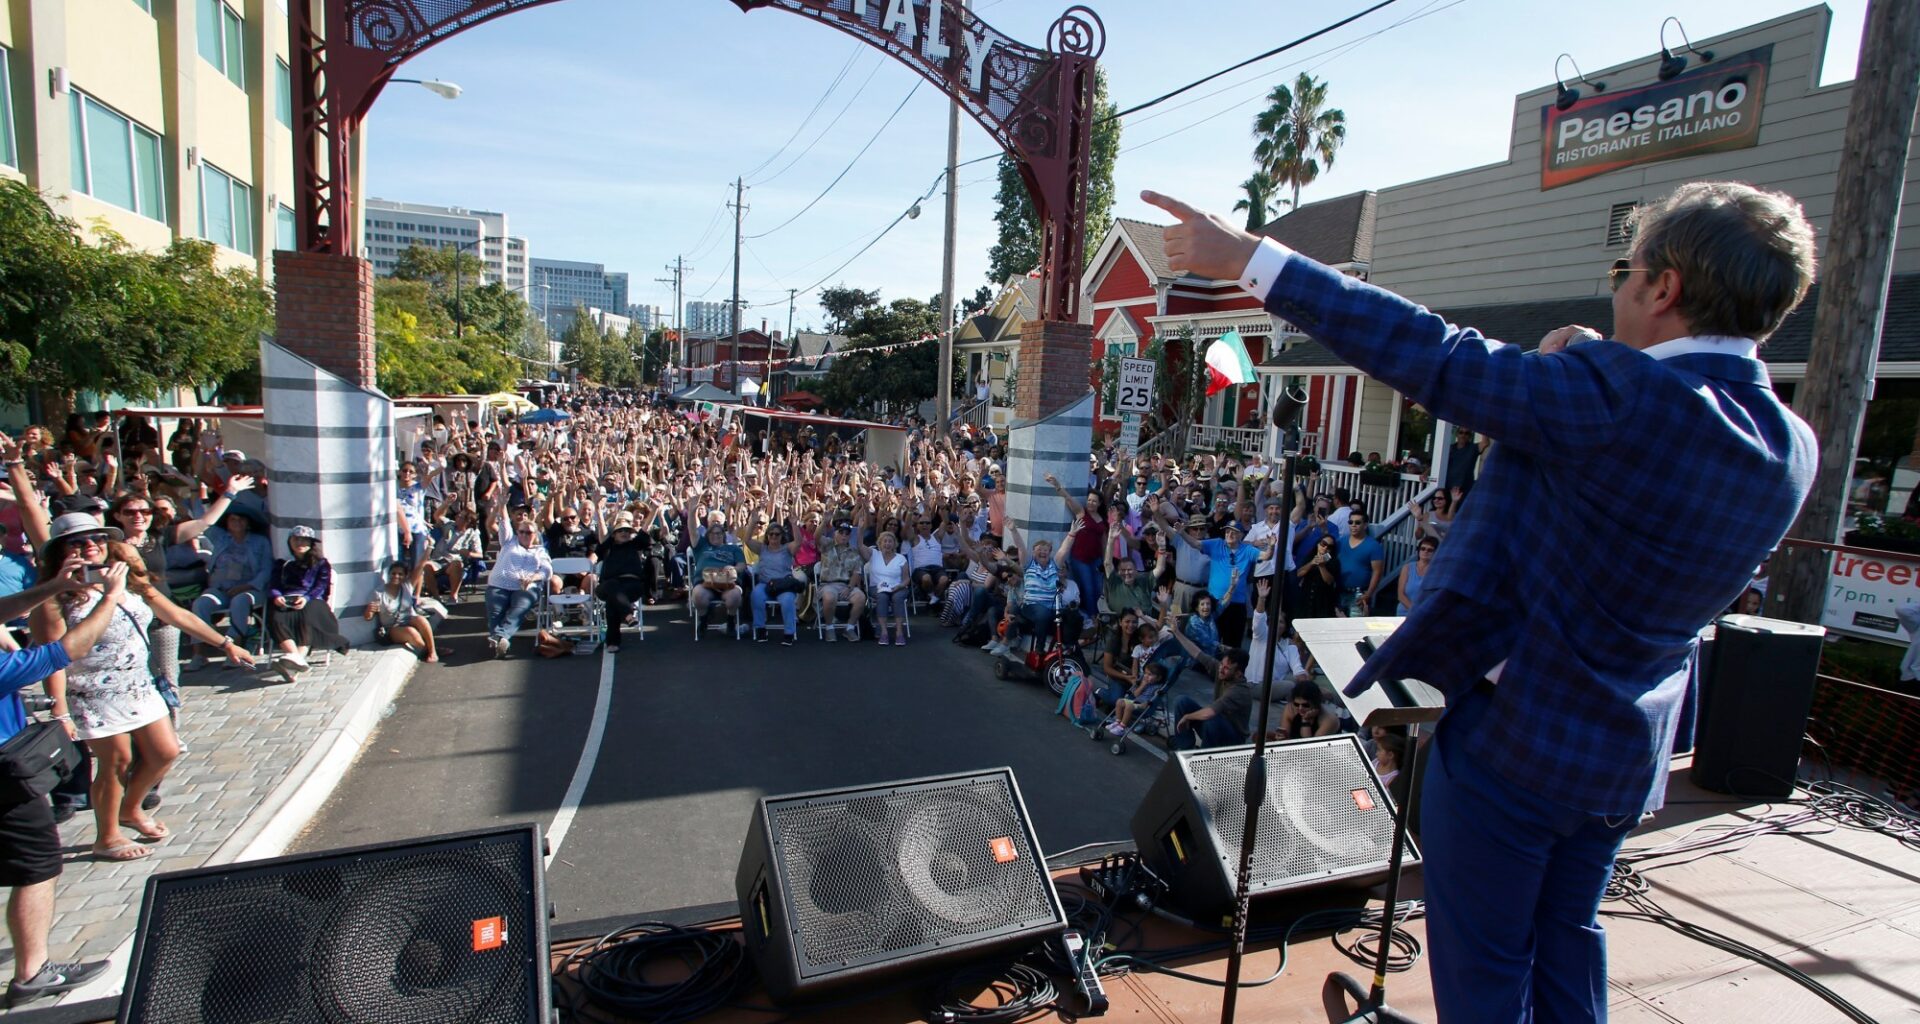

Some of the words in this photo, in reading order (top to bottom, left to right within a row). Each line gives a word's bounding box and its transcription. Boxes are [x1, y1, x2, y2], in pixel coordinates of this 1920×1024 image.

[854, 0, 996, 93] ALY
[1557, 81, 1747, 149] Paesano
[1555, 132, 1651, 164] RISTORANTE
[1657, 111, 1741, 142] ITALIANO
[1123, 362, 1153, 373] SPEED
[1125, 375, 1149, 385] LIMIT
[1120, 387, 1149, 407] 25
[1833, 585, 1876, 604] 7pm
[1236, 854, 1254, 954] ULTIMATE
[481, 922, 495, 944] JBL
